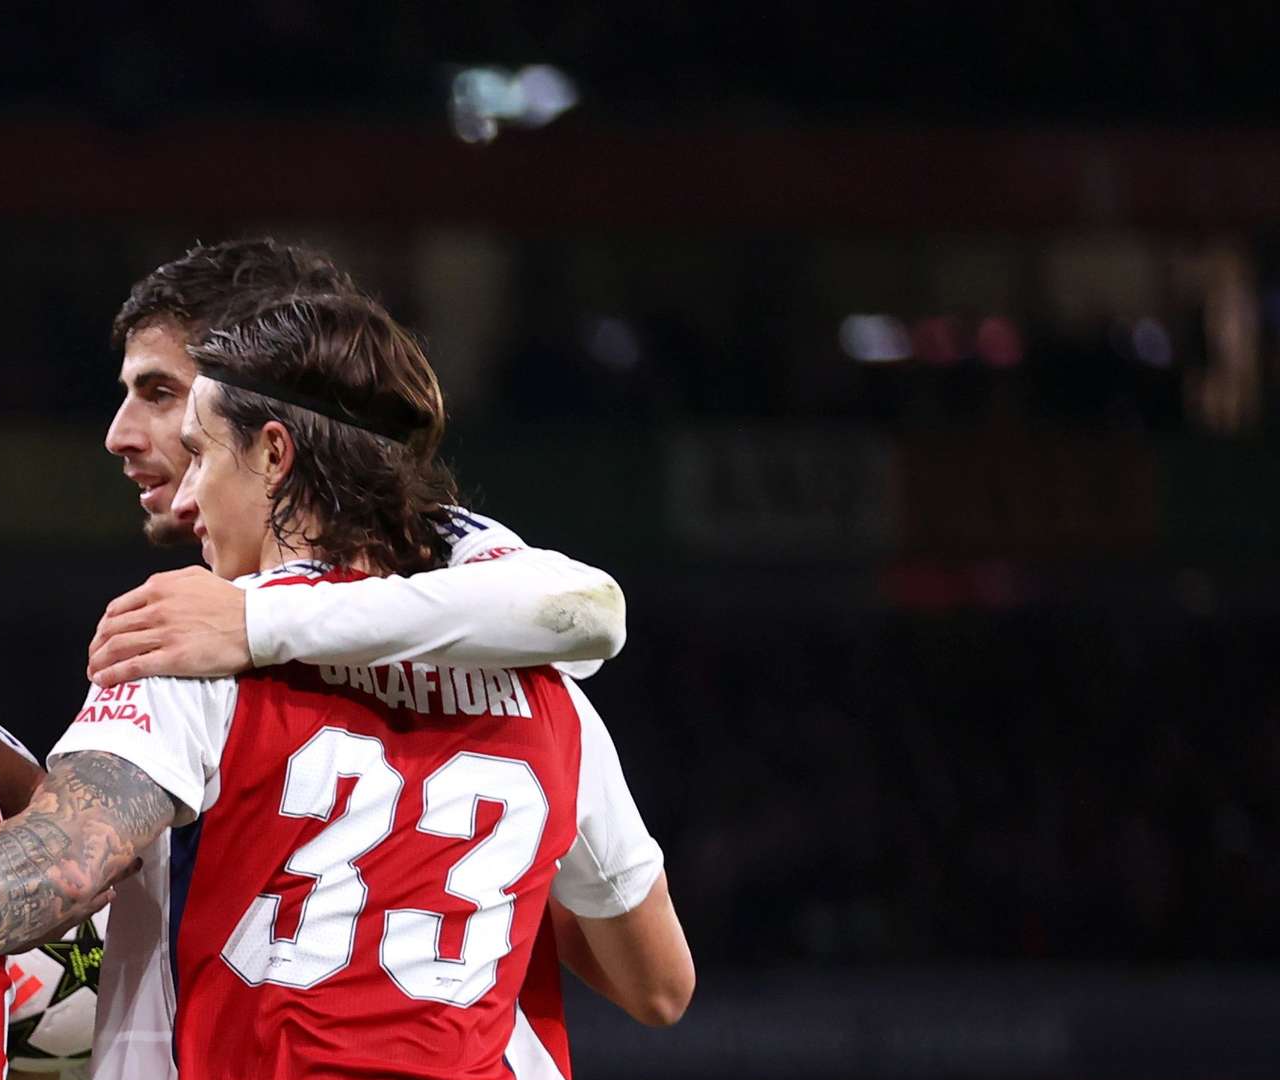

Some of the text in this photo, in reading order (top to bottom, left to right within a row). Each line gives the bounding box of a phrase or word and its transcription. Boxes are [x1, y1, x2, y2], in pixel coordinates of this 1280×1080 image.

[95, 681, 142, 702] ISIT
[75, 703, 151, 734] ANDA
[220, 726, 550, 1009] 33
